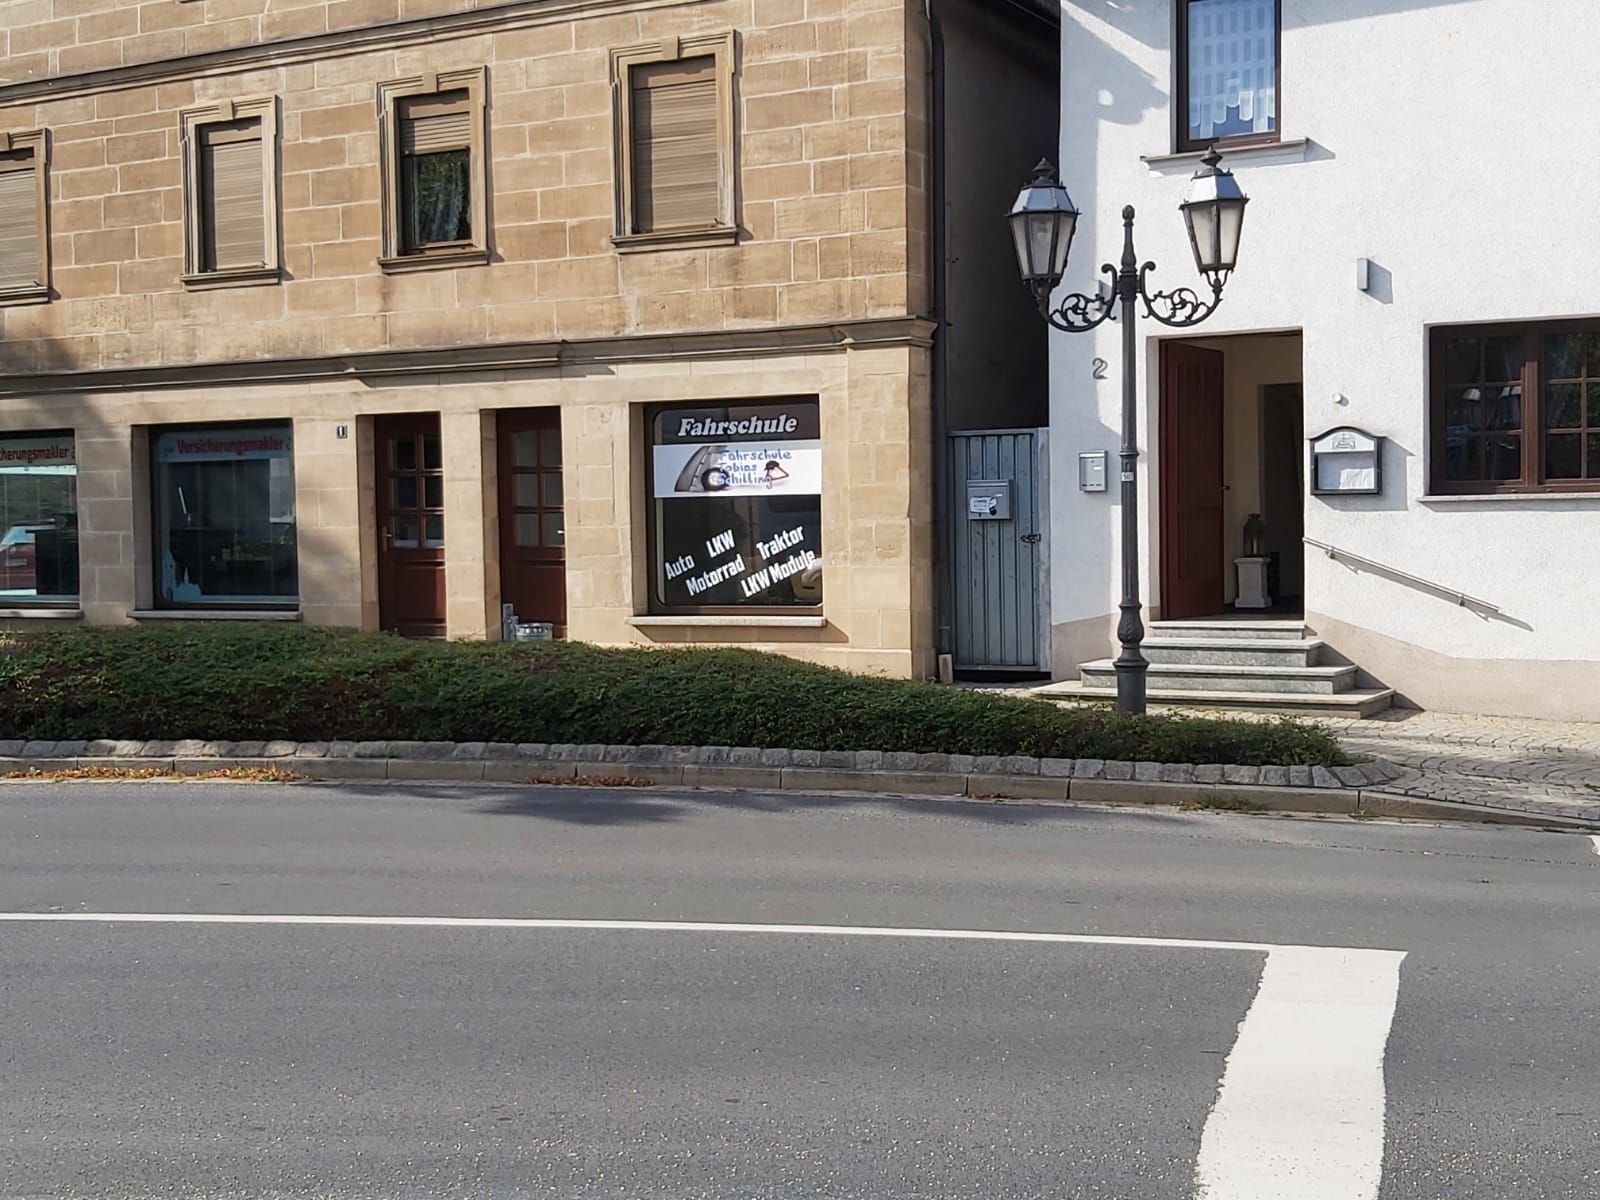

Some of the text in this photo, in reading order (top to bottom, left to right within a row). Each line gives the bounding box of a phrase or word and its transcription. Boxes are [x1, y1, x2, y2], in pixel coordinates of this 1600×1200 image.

[1092, 357, 1105, 379] 2
[678, 414, 797, 436] Fahrschule
[177, 436, 283, 454] Versicherungsmakler
[718, 448, 792, 461] Fahrschule
[718, 462, 757, 472] Tobias
[717, 473, 772, 489] Schilling
[706, 530, 735, 558] LKW
[756, 526, 804, 560] Traktor
[665, 555, 695, 580] Auto
[686, 554, 745, 596] Motorrad
[741, 550, 815, 597] LKW Module
